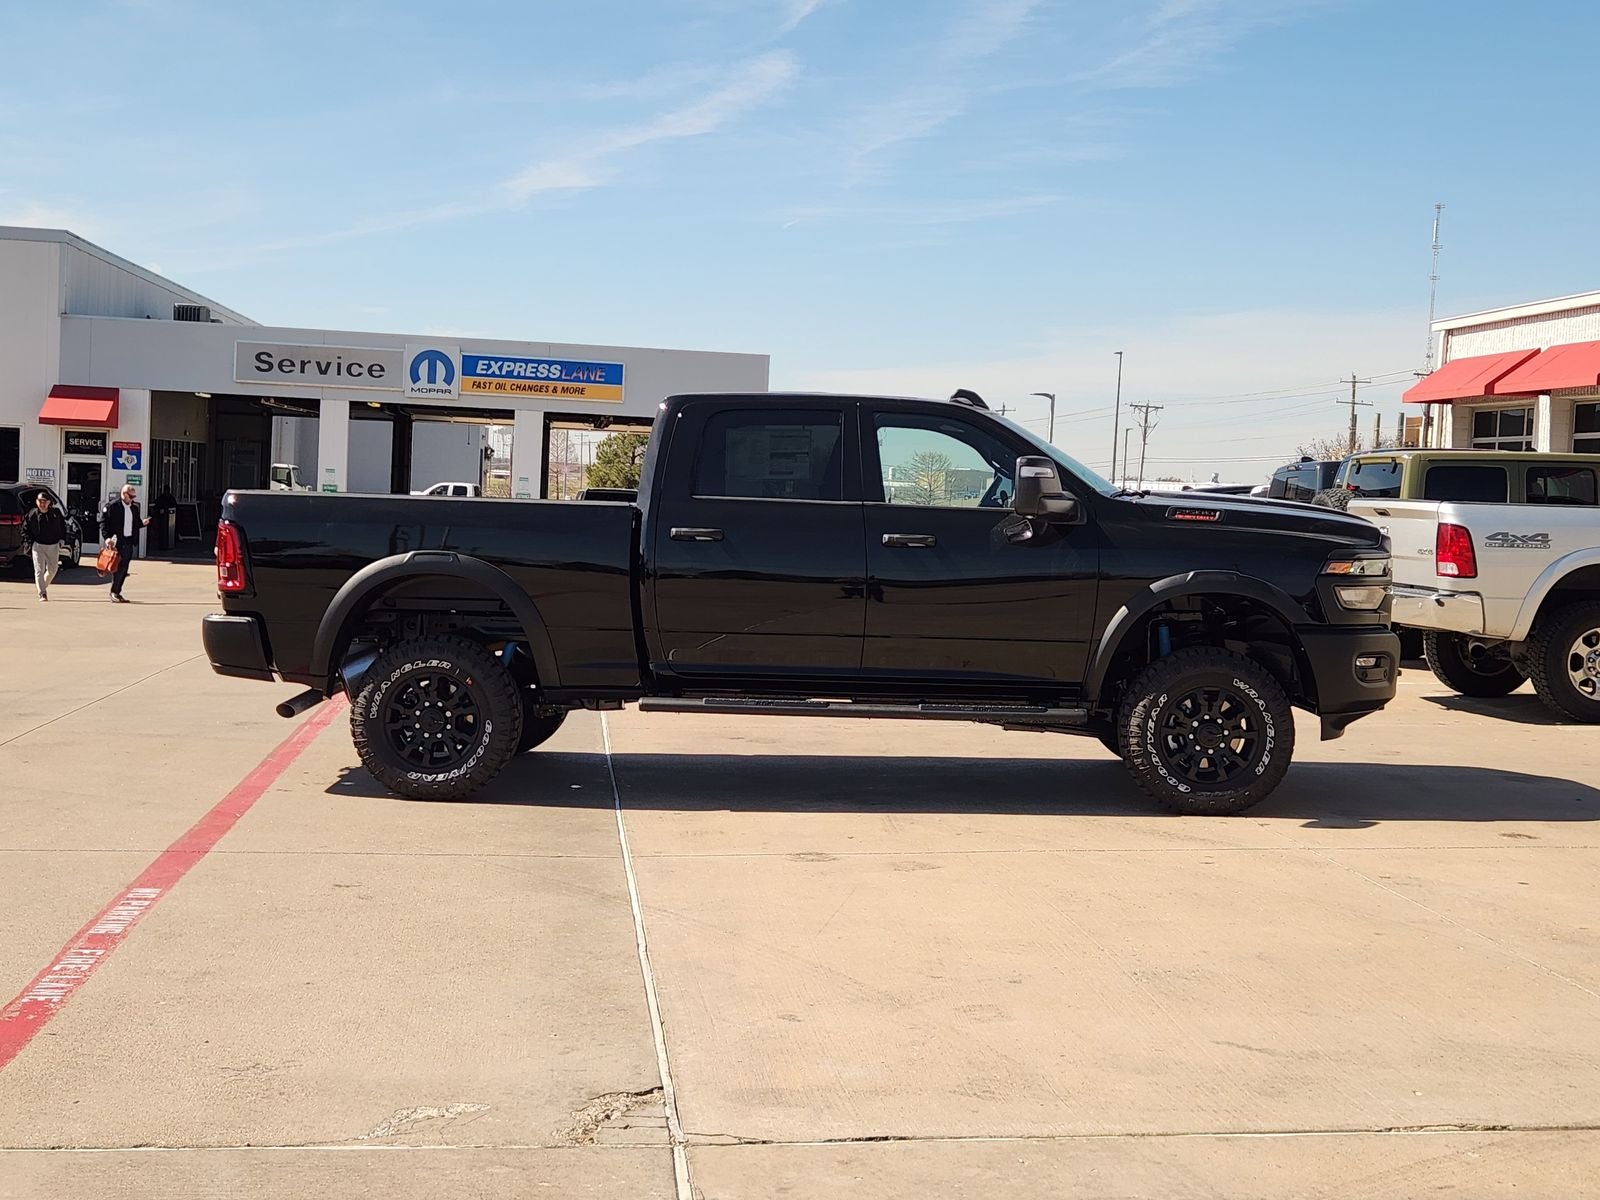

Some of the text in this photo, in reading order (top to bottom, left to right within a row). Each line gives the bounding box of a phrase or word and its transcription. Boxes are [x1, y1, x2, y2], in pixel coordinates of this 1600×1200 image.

[254, 351, 387, 379] Service
[410, 386, 452, 395] MOPAR
[472, 381, 587, 396] FAST OIL CHANGES & MORE
[69, 437, 103, 447] SERVICE
[26, 468, 54, 477] NOTICE
[369, 660, 452, 719] WRANGLER
[1233, 679, 1275, 775] WRANGLER
[407, 720, 493, 782] GOODYEAR
[1147, 694, 1191, 793] GOODYEAR
